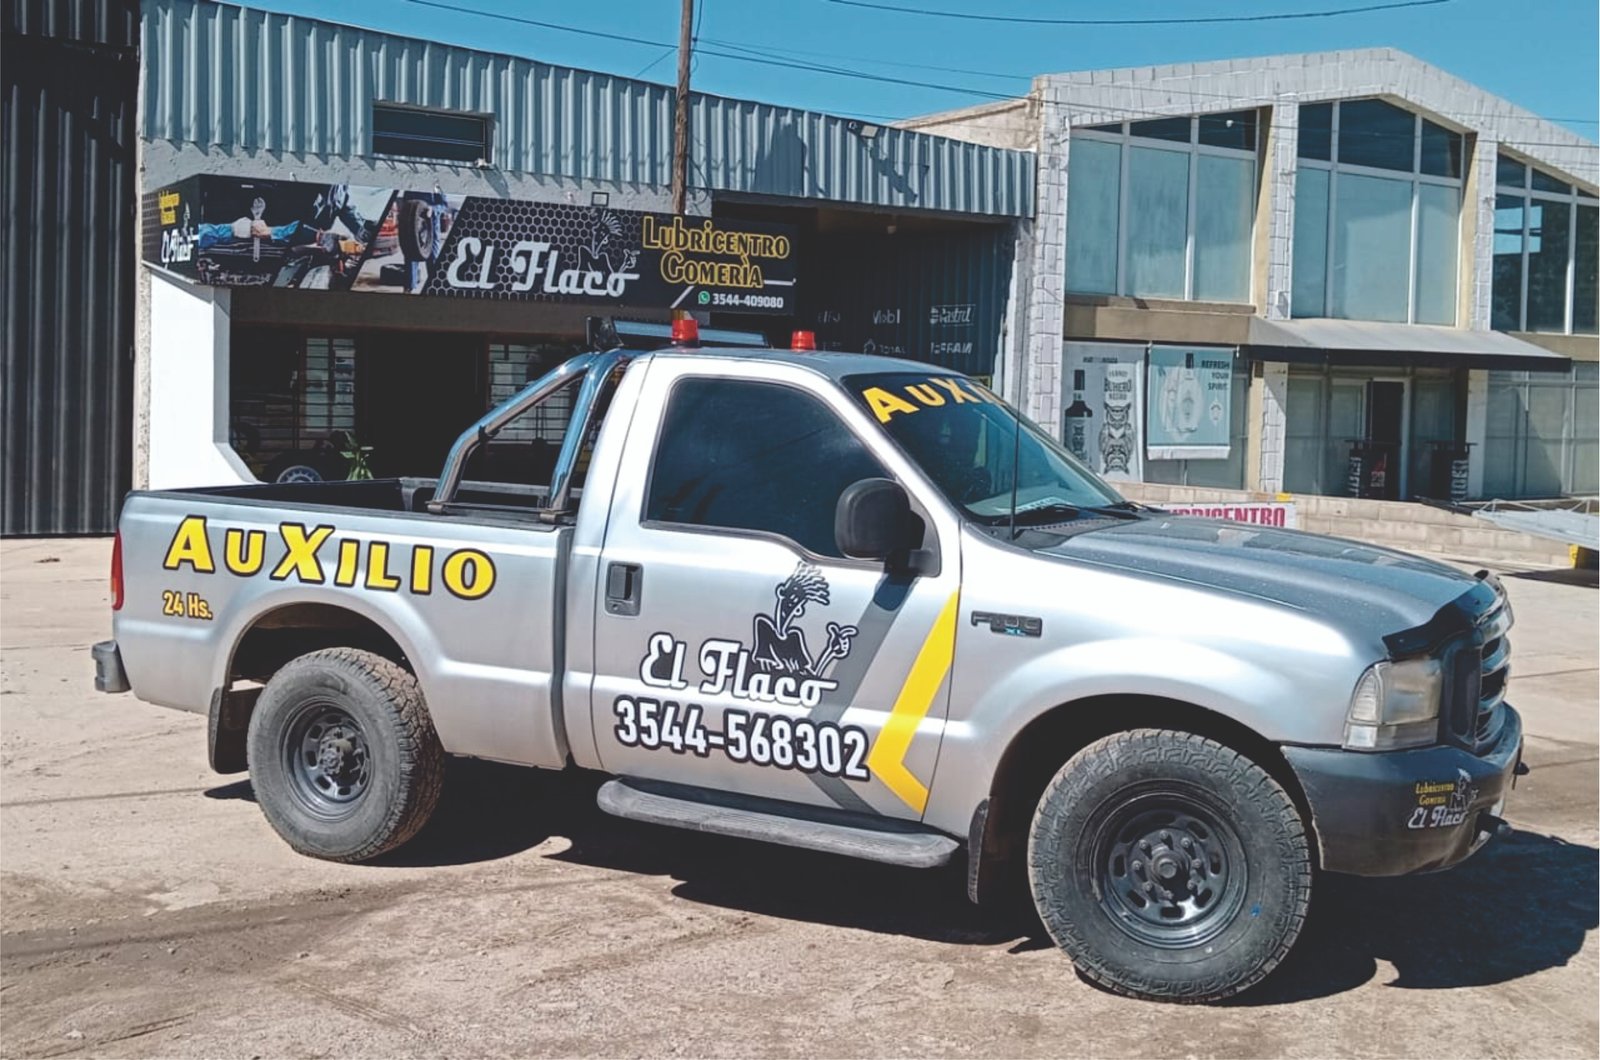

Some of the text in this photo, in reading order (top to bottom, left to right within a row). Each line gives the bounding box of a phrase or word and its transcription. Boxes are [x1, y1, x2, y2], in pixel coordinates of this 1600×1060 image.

[447, 237, 641, 298] El Flaco
[712, 292, 784, 309] 3544-409080
[162, 590, 213, 621] 24 Hs.
[640, 632, 838, 708] El Flaco
[613, 694, 871, 783] 3544-568302
[1408, 807, 1428, 829] El
